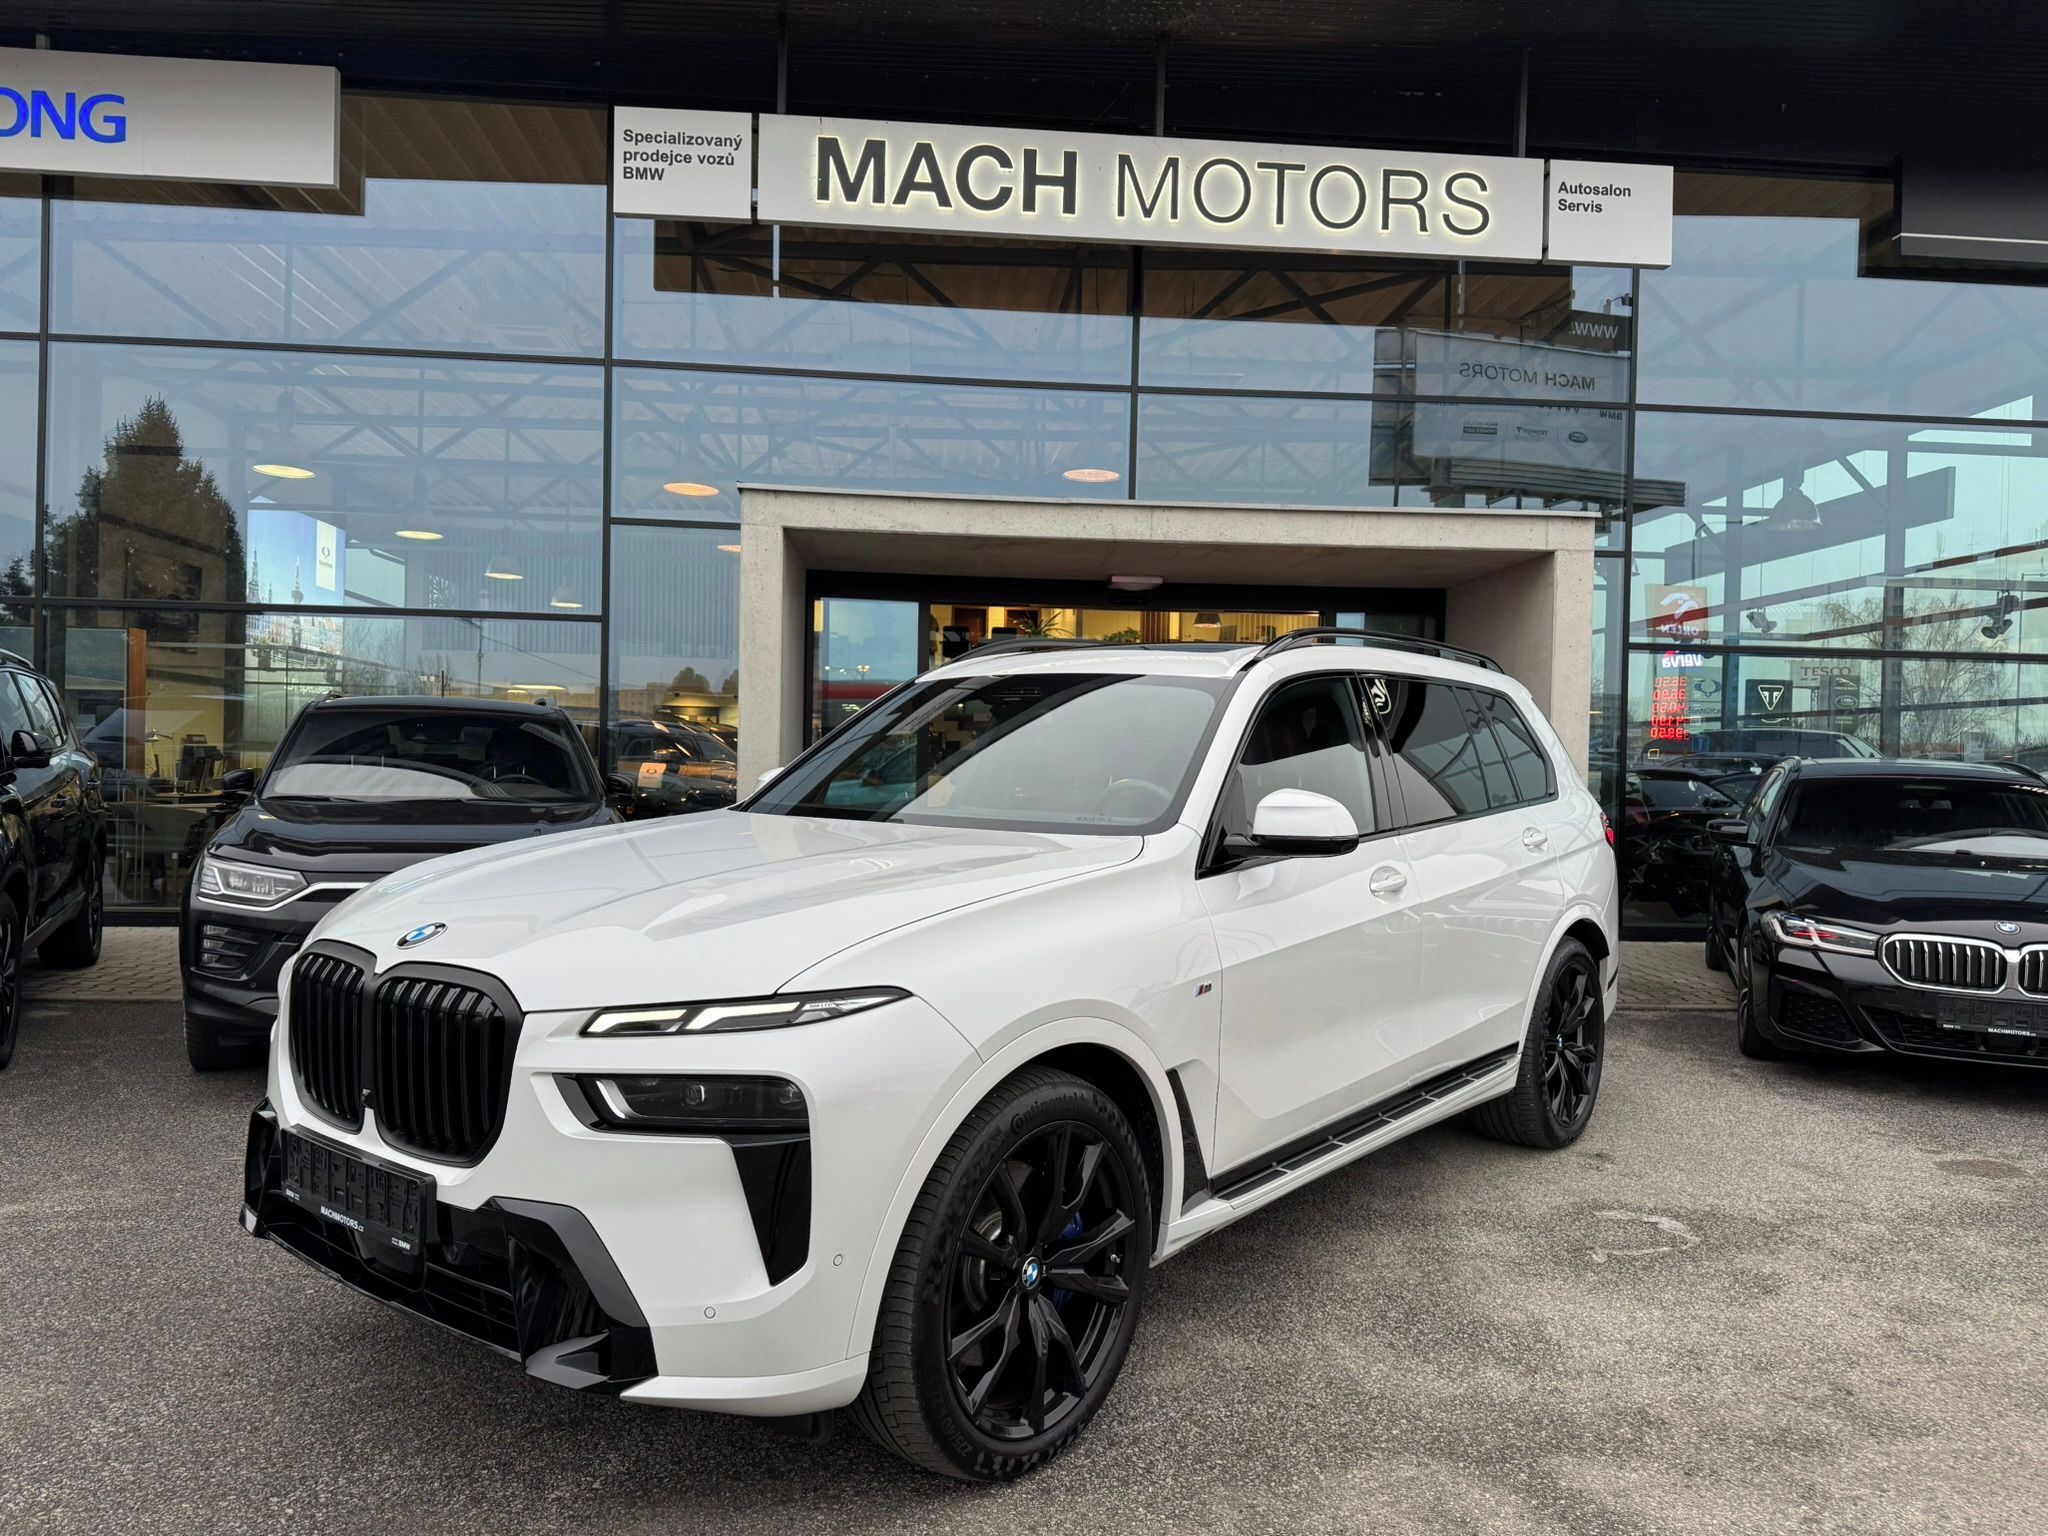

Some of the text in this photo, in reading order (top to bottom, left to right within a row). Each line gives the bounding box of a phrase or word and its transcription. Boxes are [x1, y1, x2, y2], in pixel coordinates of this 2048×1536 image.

[623, 128, 743, 151] Specializovaný
[623, 148, 735, 166] prodejce vozů
[623, 166, 665, 181] BMW
[815, 136, 1491, 236] MACH MOTORS
[1558, 181, 1632, 197] Autosalon
[1558, 198, 1603, 213] Servis
[1800, 666, 1852, 677] TESCO
